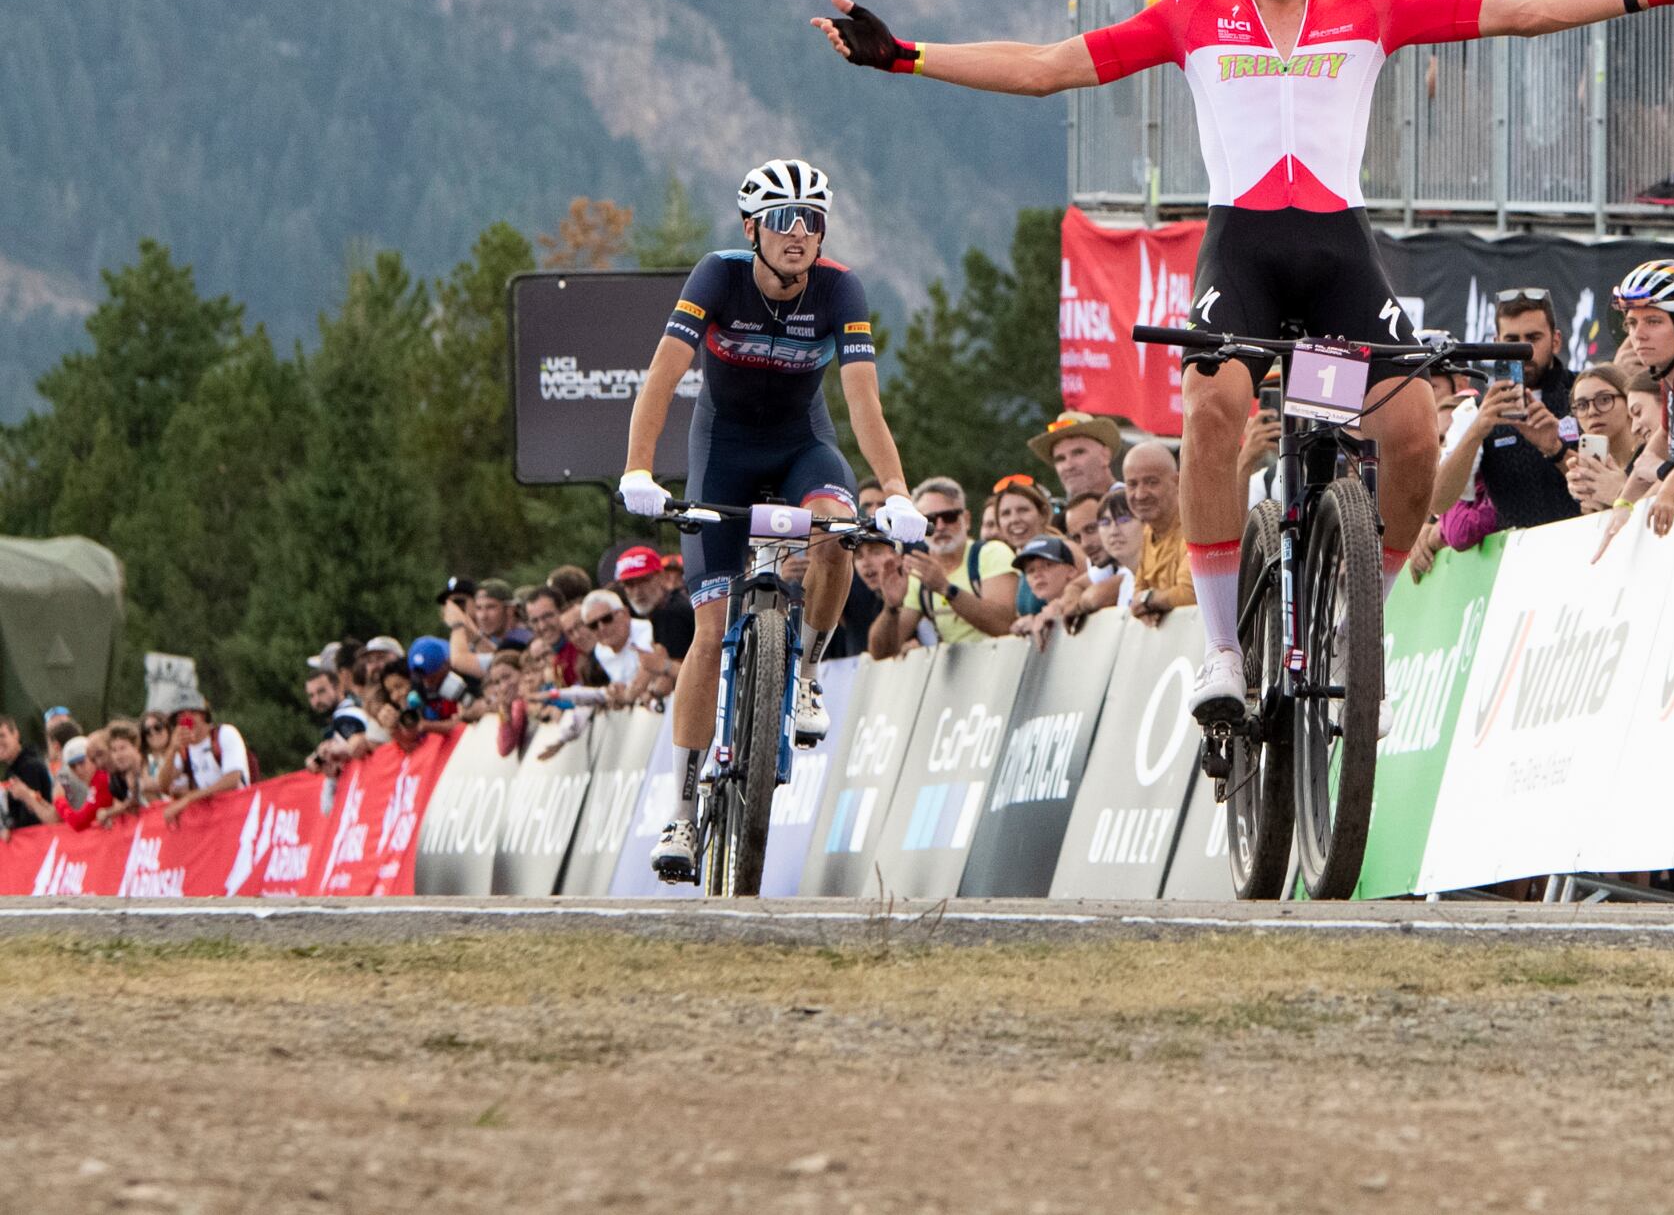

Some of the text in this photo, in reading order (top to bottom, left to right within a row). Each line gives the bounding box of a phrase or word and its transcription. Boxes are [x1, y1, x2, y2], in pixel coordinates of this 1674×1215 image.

[1217, 53, 1348, 81] TRINITY
[731, 319, 764, 332] Santini
[719, 338, 824, 362] TREK
[546, 356, 577, 371] UCI
[539, 368, 650, 387] MOUNTA
[1317, 364, 1337, 399] 1
[540, 384, 632, 400] WORLD
[769, 509, 793, 534] 6
[928, 703, 1003, 773] GoPro
[1088, 807, 1175, 865] OAKLEY
